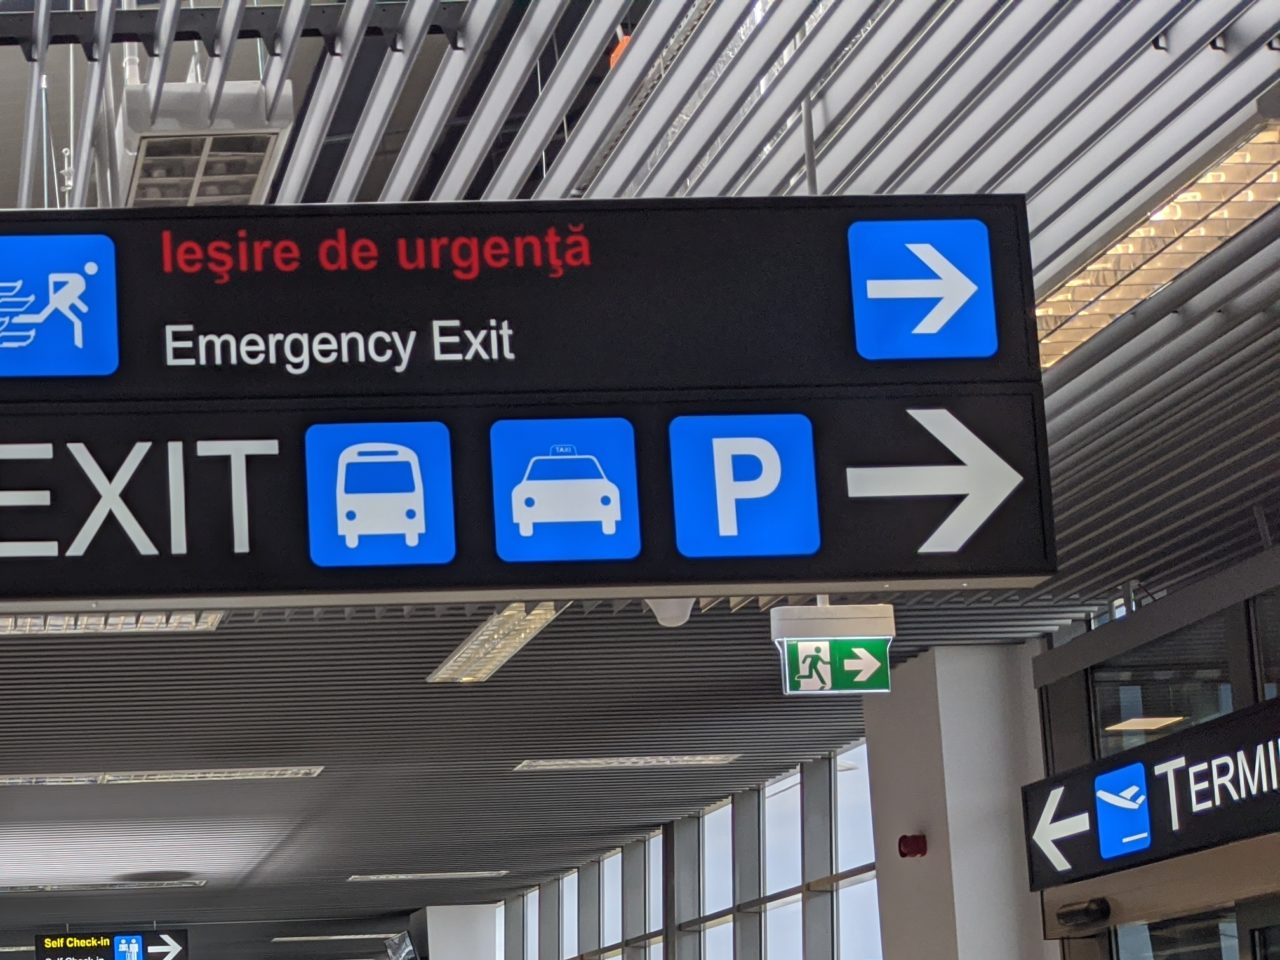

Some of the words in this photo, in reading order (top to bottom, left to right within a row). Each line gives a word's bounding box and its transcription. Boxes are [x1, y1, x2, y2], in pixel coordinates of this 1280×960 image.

[318, 228, 379, 272] de
[165, 325, 417, 375] Emergency
[432, 319, 516, 361] Exit
[712, 437, 782, 537] P
[1153, 738, 1280, 832] TERMI
[43, 937, 64, 949] Self
[66, 936, 111, 948] Check-in
